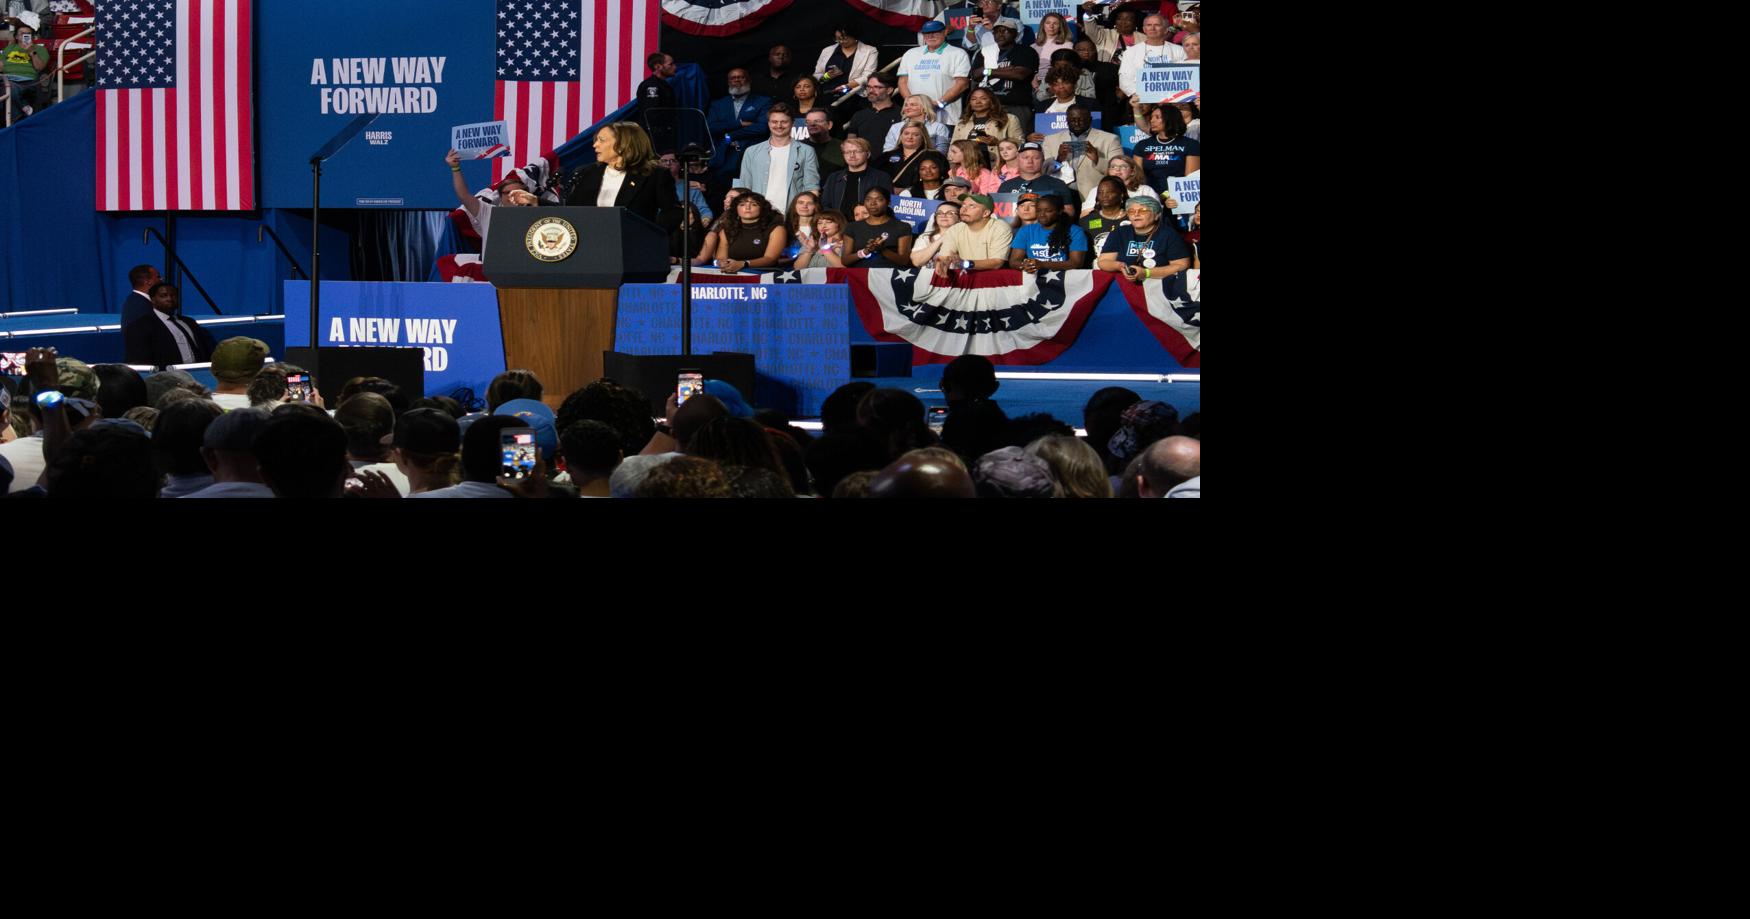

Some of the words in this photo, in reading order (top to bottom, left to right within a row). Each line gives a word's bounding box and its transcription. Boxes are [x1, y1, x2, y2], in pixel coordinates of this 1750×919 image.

[1025, 0, 1031, 9] A
[1033, 0, 1051, 8] NEW
[311, 58, 327, 85] A
[332, 58, 386, 84] NEW
[392, 57, 446, 83] WAY
[1141, 72, 1147, 81] A
[1150, 72, 1170, 81] NEW
[1172, 71, 1193, 80] WAY
[1145, 81, 1189, 92] FORWARD
[320, 87, 437, 114] FORWARD
[365, 131, 392, 140] HARRIS
[456, 129, 460, 139] A
[462, 127, 480, 138] NEW
[482, 125, 501, 136] WAY
[458, 136, 499, 149] FORWARD
[1175, 182, 1181, 191] A
[1180, 191, 1200, 202] FOR
[900, 199, 922, 208] NORTH
[894, 206, 925, 216] CAROLINA
[691, 287, 749, 301] HARLOTTE,
[751, 287, 767, 300] NC
[329, 317, 344, 342] A
[350, 318, 400, 343] NEW
[405, 318, 457, 344] WAY
